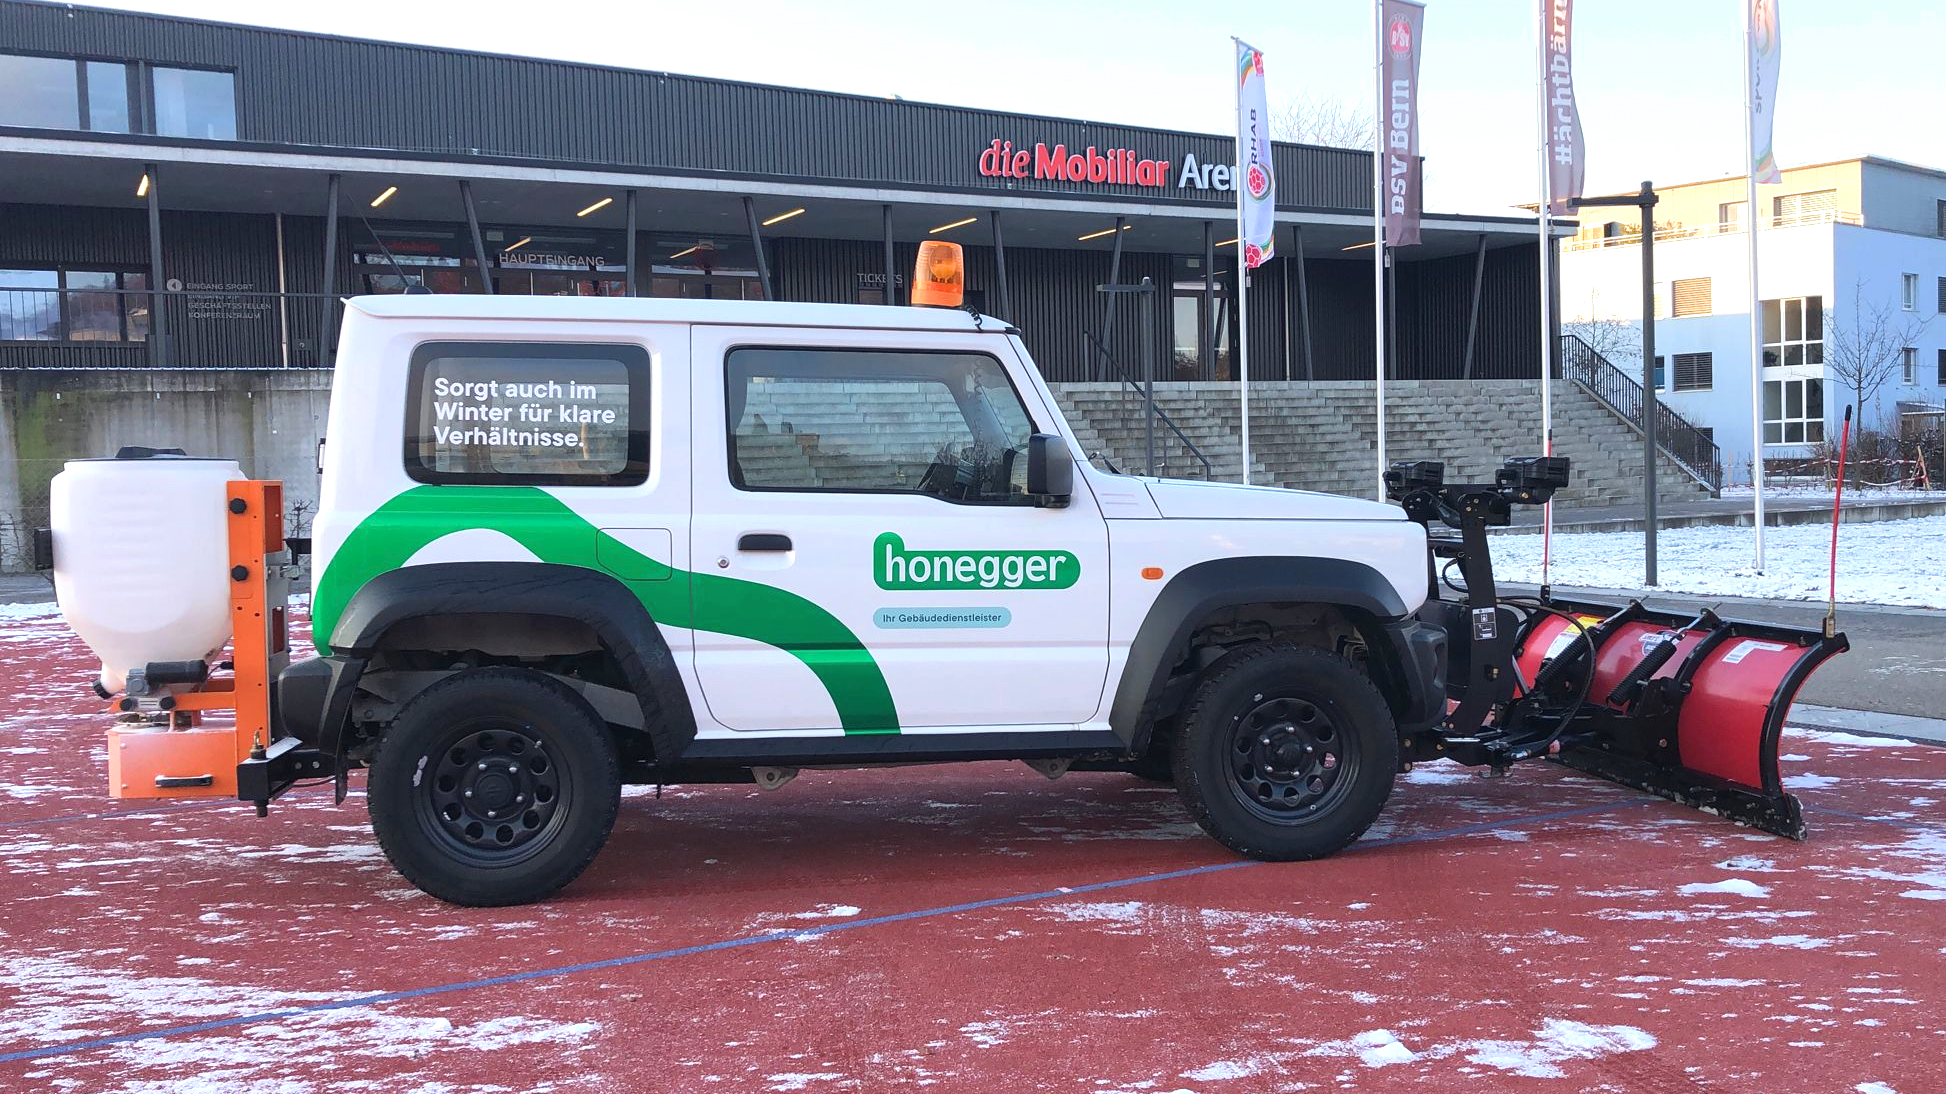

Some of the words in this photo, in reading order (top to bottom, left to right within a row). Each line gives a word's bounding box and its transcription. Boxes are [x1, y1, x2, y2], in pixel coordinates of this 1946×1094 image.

[1390, 79, 1409, 151] Bern
[979, 138, 1031, 179] die
[1034, 142, 1170, 187] Mobiliar
[499, 250, 605, 267] HAUPTEINGANG
[186, 282, 224, 290] EINGANG
[857, 273, 903, 284] TICKES
[434, 377, 499, 401] Sorgt
[505, 380, 562, 399] auch
[570, 380, 597, 399] im
[433, 402, 513, 422] Winter
[519, 403, 553, 422] für
[559, 404, 616, 424] klare
[433, 425, 585, 447] Verhältnisse.
[885, 543, 1067, 588] honegger
[883, 614, 896, 623] Ihr
[898, 613, 1002, 624] Gebäudedienstleister
